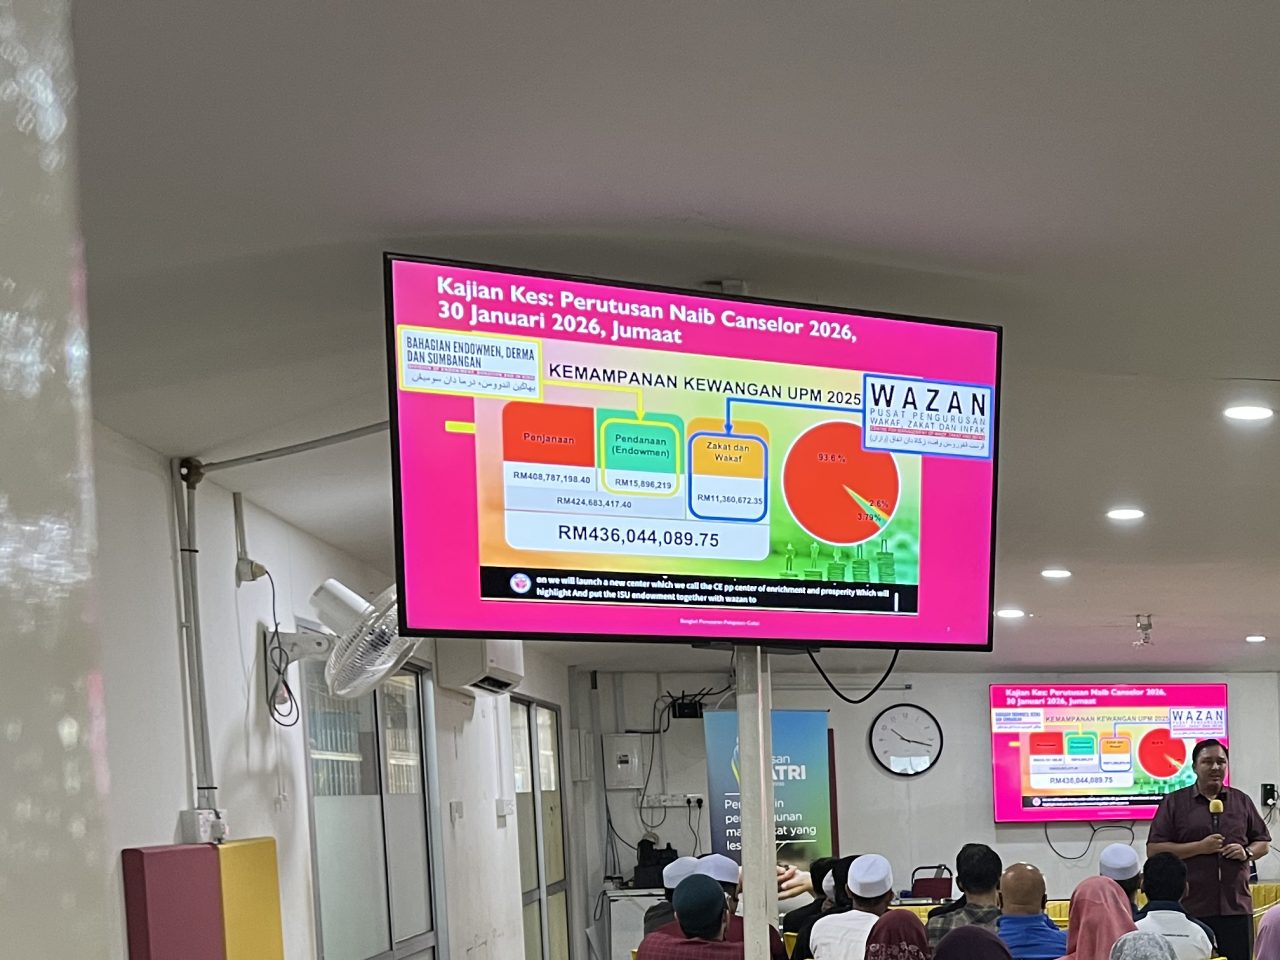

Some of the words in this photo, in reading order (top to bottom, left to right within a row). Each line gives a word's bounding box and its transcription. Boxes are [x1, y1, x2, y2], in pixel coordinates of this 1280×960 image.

[437, 276, 503, 301] Kajian
[510, 285, 554, 307] Kes:
[560, 291, 663, 319] Perutusan
[669, 304, 715, 324] Naib
[721, 310, 804, 334] Canselor
[809, 320, 857, 343] 2026,
[438, 301, 464, 320] 30
[469, 303, 545, 329] Januari
[552, 313, 606, 338] 2026,
[610, 320, 683, 344] Jumaat
[406, 336, 451, 353] BAHAGIAN
[453, 341, 504, 359] ENDOWMEN,
[506, 346, 535, 361] DERMA
[407, 350, 425, 364] DAN
[427, 352, 482, 369] SUMBANGAN
[549, 363, 677, 389] KEMAMPANAN
[684, 376, 782, 398] KEWANGAN
[788, 386, 822, 402] UPM
[827, 390, 861, 406] 2025
[870, 383, 985, 416] WAZAN
[870, 408, 905, 418] PUSAT
[912, 412, 986, 426] PENGURUSAN
[870, 418, 904, 428] WAKAF,
[907, 420, 935, 430] ZAKAT
[938, 423, 957, 432] DAN
[960, 424, 985, 434] INFAK
[523, 432, 575, 445] Penjanaan
[615, 434, 667, 446] Pendanaan
[611, 445, 670, 460] (Endowmen)
[706, 441, 731, 451] Zakat
[733, 443, 750, 452] dan
[714, 453, 742, 463] Wakaf
[513, 471, 591, 484] RM408,787,198.40
[615, 478, 672, 490] RM15,896,219
[556, 497, 632, 509] RM424,683,417.40
[697, 493, 763, 505] RM11,360,672.35
[558, 525, 719, 548] RM436,044,089.75
[561, 576, 575, 585] will
[576, 577, 602, 586] launch
[626, 580, 650, 588] center
[651, 580, 673, 589] which
[686, 582, 700, 590] call
[700, 582, 712, 590] the
[724, 584, 734, 592] pp
[734, 584, 757, 592] center
[758, 584, 766, 592] of
[766, 585, 806, 594] enrichment
[820, 588, 855, 598] prosperity
[856, 589, 876, 597] Which
[877, 590, 890, 598] will
[536, 587, 572, 598] highlight
[572, 588, 588, 597] And
[588, 590, 602, 598] put
[603, 590, 616, 598] the
[631, 592, 676, 601] endowment
[676, 593, 707, 602] together
[708, 594, 724, 602] with
[748, 596, 757, 604] to
[1050, 688, 1089, 696] Perutusan
[1017, 698, 1045, 706] Januari
[1172, 710, 1224, 721] WAZAN
[790, 826, 816, 837] yang
